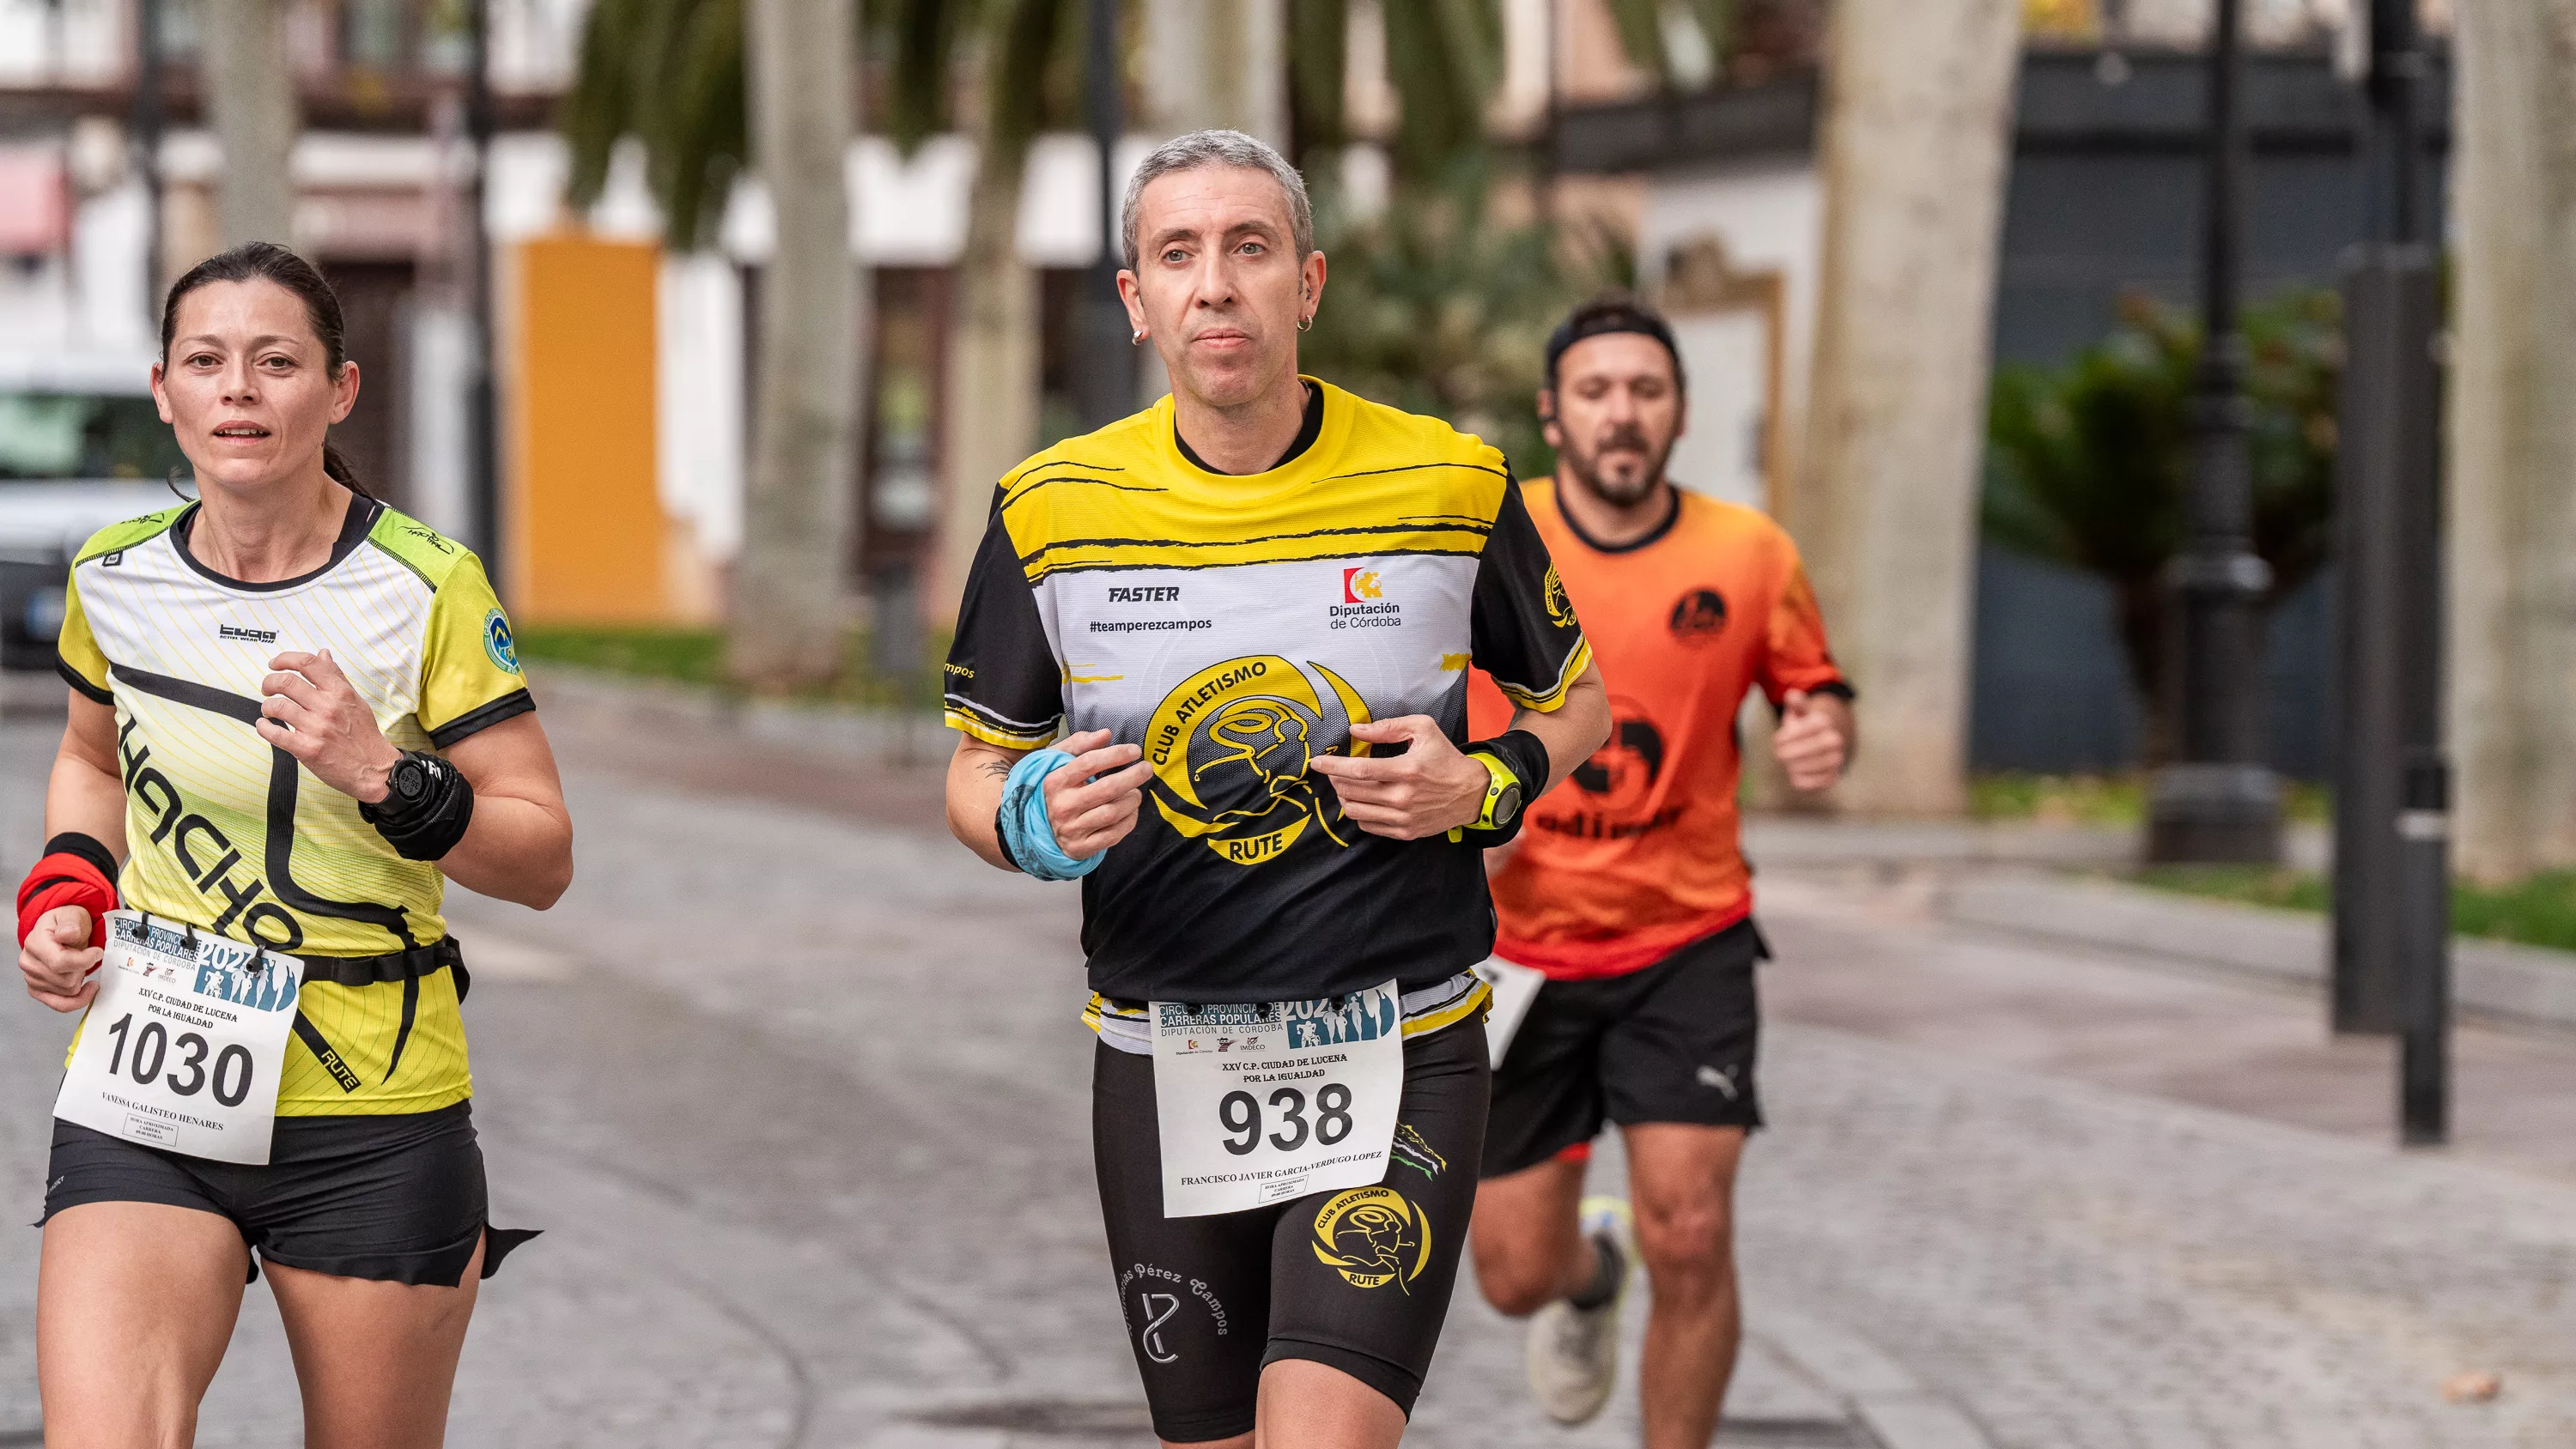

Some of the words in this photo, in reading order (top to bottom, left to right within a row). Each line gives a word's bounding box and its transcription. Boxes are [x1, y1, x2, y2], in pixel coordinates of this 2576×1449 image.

[1109, 586, 1180, 603] FASTER
[1329, 603, 1400, 617] Diputación
[1330, 618, 1346, 629] de
[1350, 615, 1401, 628] Córdoba
[1090, 619, 1212, 634] #teamperezcampos
[1152, 724, 1180, 766] CLUB
[1176, 662, 1267, 724] ATLETISMO
[1230, 833, 1283, 860] RUTE
[155, 939, 198, 962] POPULARES
[200, 943, 259, 973] 202
[138, 987, 154, 998] XXV
[152, 991, 164, 1002] C.P.
[165, 995, 192, 1010] CIUDAD
[192, 1003, 204, 1014] DE
[205, 1007, 238, 1022] LUCENA
[148, 1003, 161, 1015] POR
[161, 1008, 172, 1018] LA
[173, 1011, 214, 1029] IGUALDAD
[1159, 1003, 1205, 1016] CIRCU
[1207, 1003, 1258, 1014] PROVINCIA
[1161, 1024, 1218, 1037] DIPUTACIÓN
[1222, 1026, 1233, 1034] DE
[108, 1012, 253, 1107] 1030
[321, 1049, 358, 1089] RUTE
[1222, 1061, 1242, 1071] XXV
[1261, 1058, 1295, 1070] CIUDAD
[1297, 1057, 1310, 1067] DE
[1311, 1053, 1348, 1065] LUCENA
[1243, 1075, 1262, 1083] POR
[1263, 1073, 1276, 1082] LA
[1278, 1069, 1326, 1081] IGUALDAD
[102, 1091, 131, 1108] VANESSA
[131, 1101, 177, 1120] GALISTEO
[179, 1113, 224, 1131] HENARES
[1218, 1082, 1353, 1155] 938
[1181, 1173, 1237, 1186] FRANCISCO
[1238, 1170, 1273, 1181] JAVIER
[1274, 1155, 1351, 1178] GARCIA-VERDUGO
[1352, 1150, 1382, 1162] LOPEZ
[1317, 1209, 1336, 1229] CLUB
[1335, 1190, 1389, 1210] ATLETISMO
[1348, 1273, 1380, 1286] RUTE
[1133, 1263, 1182, 1283] Pérez
[1189, 1278, 1228, 1336] Campos
